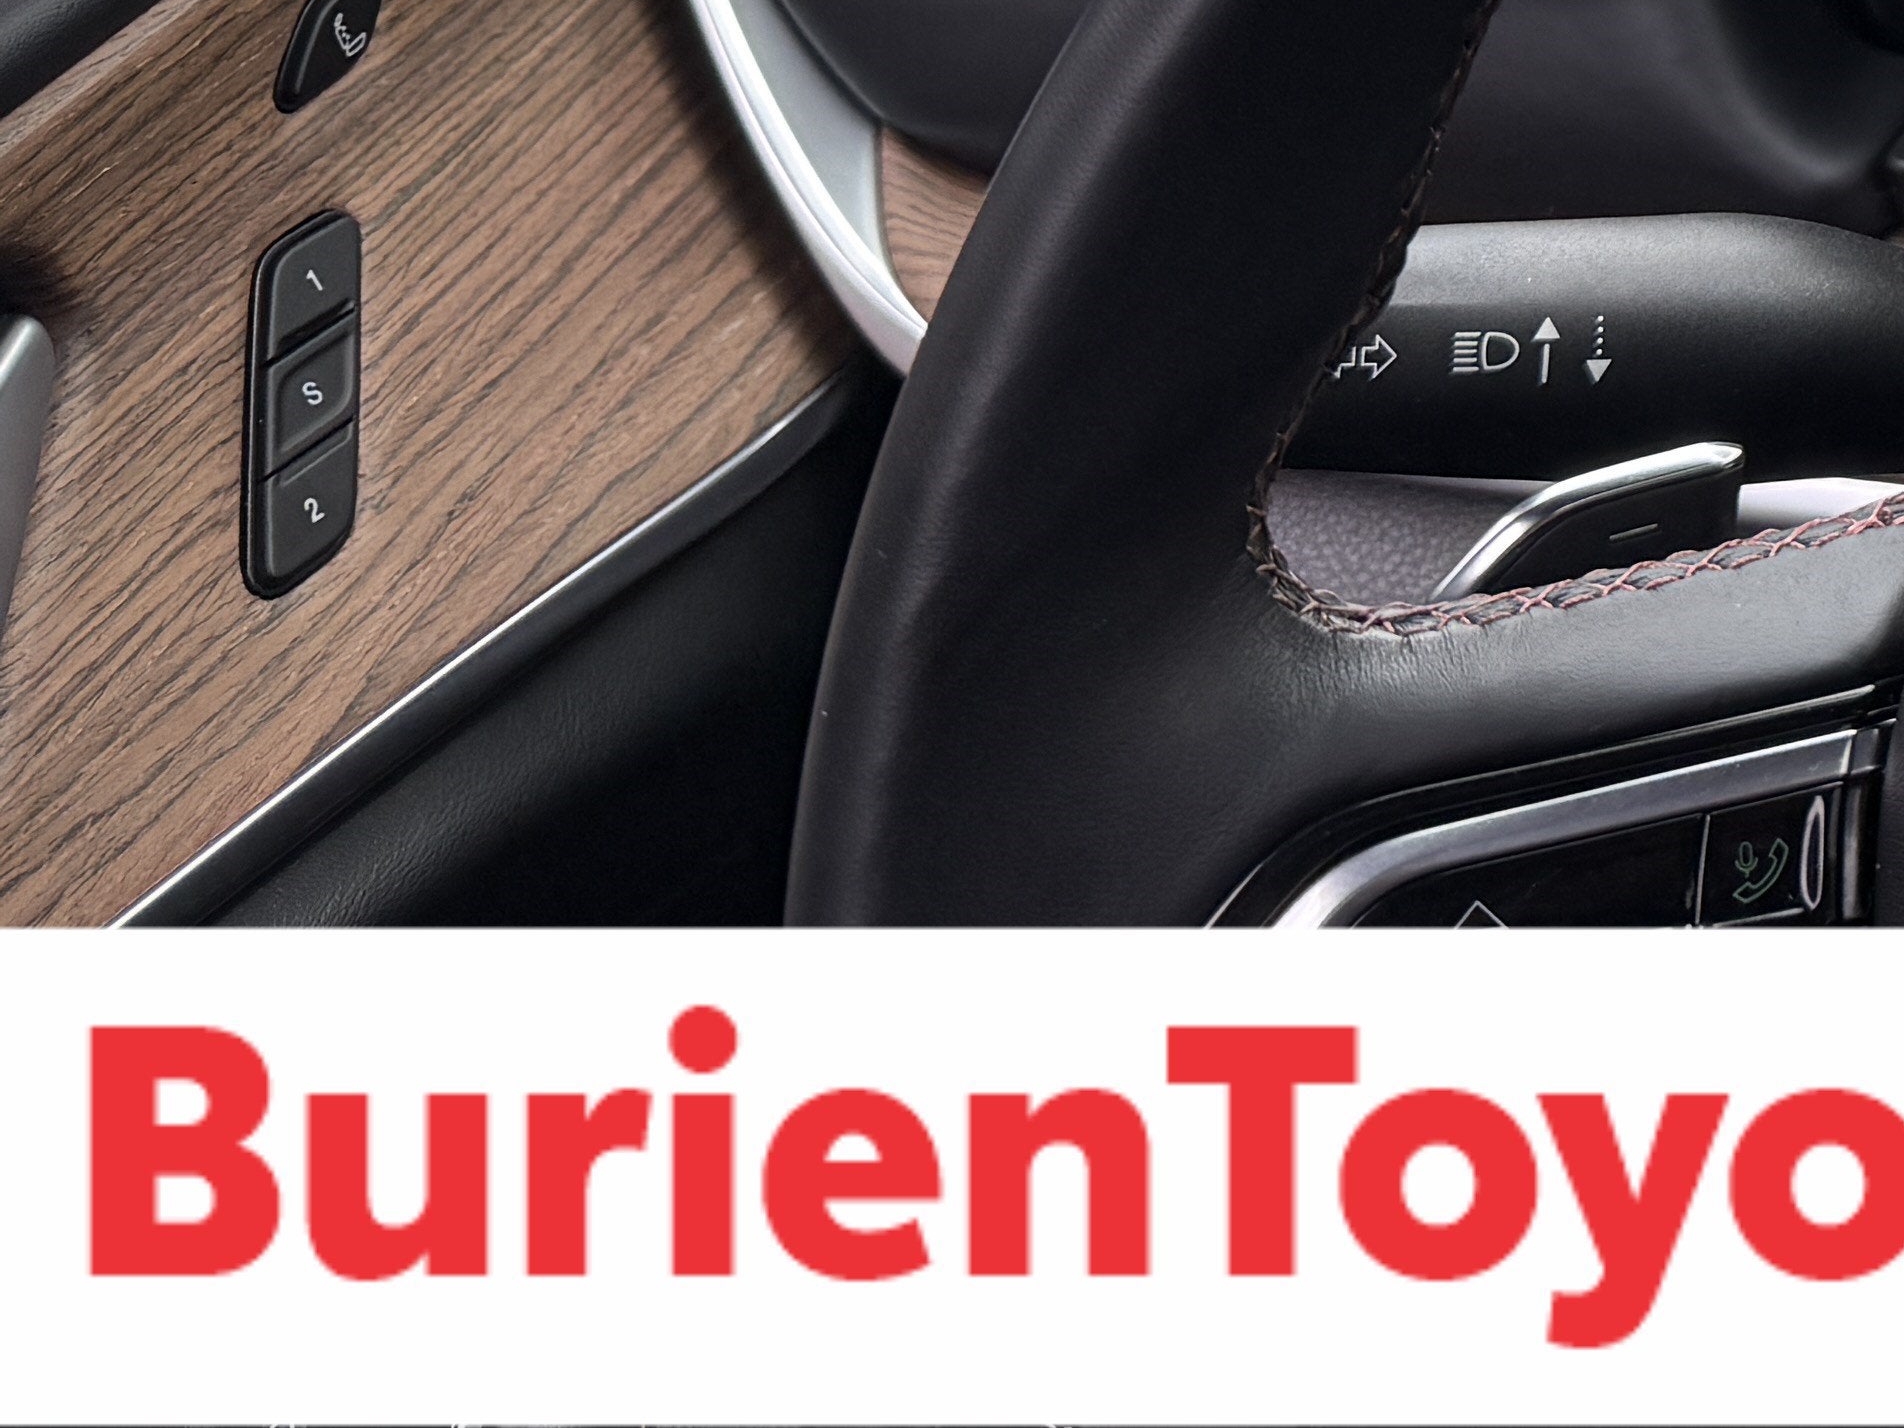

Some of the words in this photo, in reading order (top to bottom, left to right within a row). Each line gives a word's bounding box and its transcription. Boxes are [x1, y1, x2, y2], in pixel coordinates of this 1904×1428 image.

[304, 270, 325, 293] 1
[301, 380, 323, 406] S
[303, 498, 326, 524] 2
